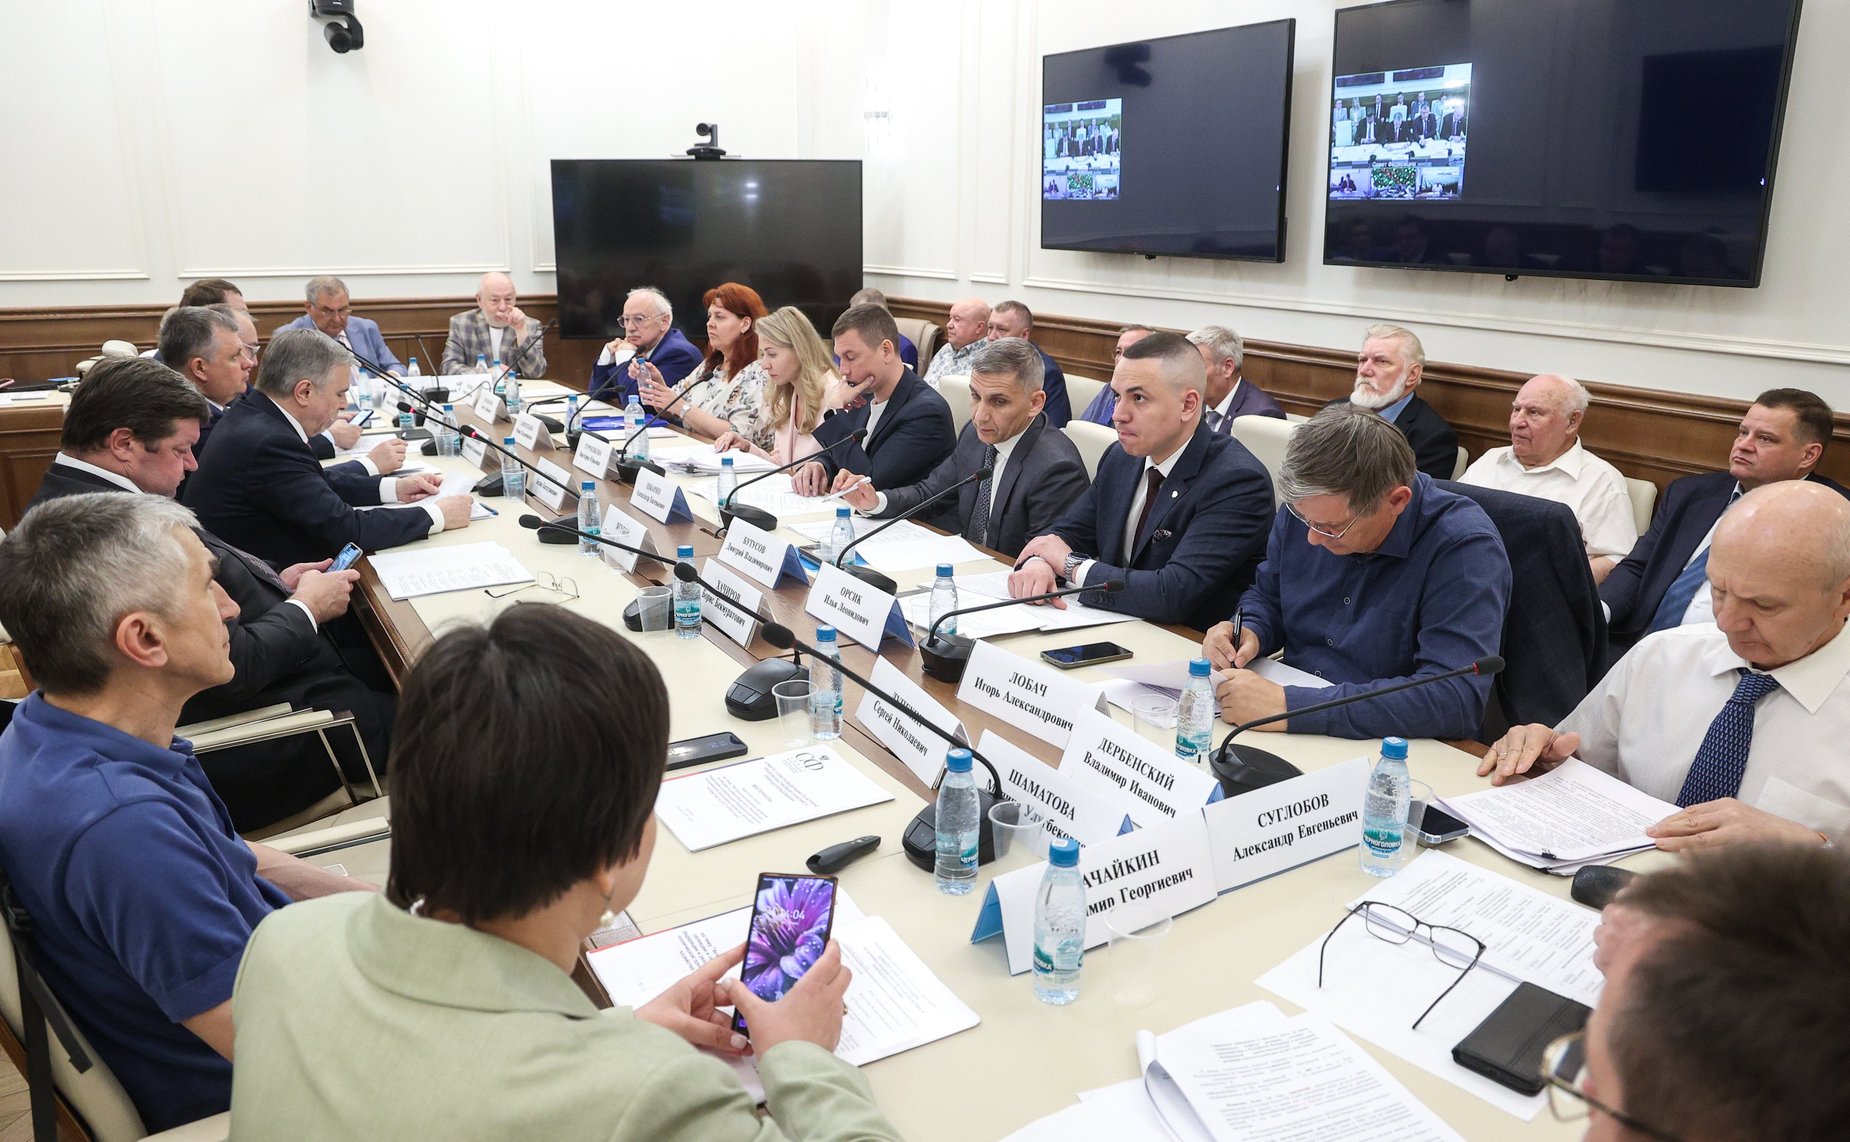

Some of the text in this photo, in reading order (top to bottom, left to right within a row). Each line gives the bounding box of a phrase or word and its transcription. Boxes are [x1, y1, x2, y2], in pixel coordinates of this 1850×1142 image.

[726, 542, 774, 573] Дмитрий Владимирович
[742, 536, 766, 554] БУТУСОВ
[701, 588, 715, 604] Борис
[823, 594, 870, 627] Илья Леонидович
[840, 586, 863, 605] ОРСИК
[1008, 672, 1048, 697] ЛОБАЧ
[974, 677, 1074, 732] Игорь Александрович
[873, 700, 928, 756] Сергей Николаевич
[1097, 737, 1175, 791] ДЕРБЕНСКИЙ
[1008, 768, 1076, 821] ШАМАТОВА
[1083, 751, 1177, 818] Владимир Иванович
[1257, 793, 1330, 828] СУГЛОБОВ
[1233, 810, 1359, 861] Александр Евгеньевич
[1083, 849, 1161, 889] АЧАЙКИН
[1119, 867, 1194, 903] Георгиевич
